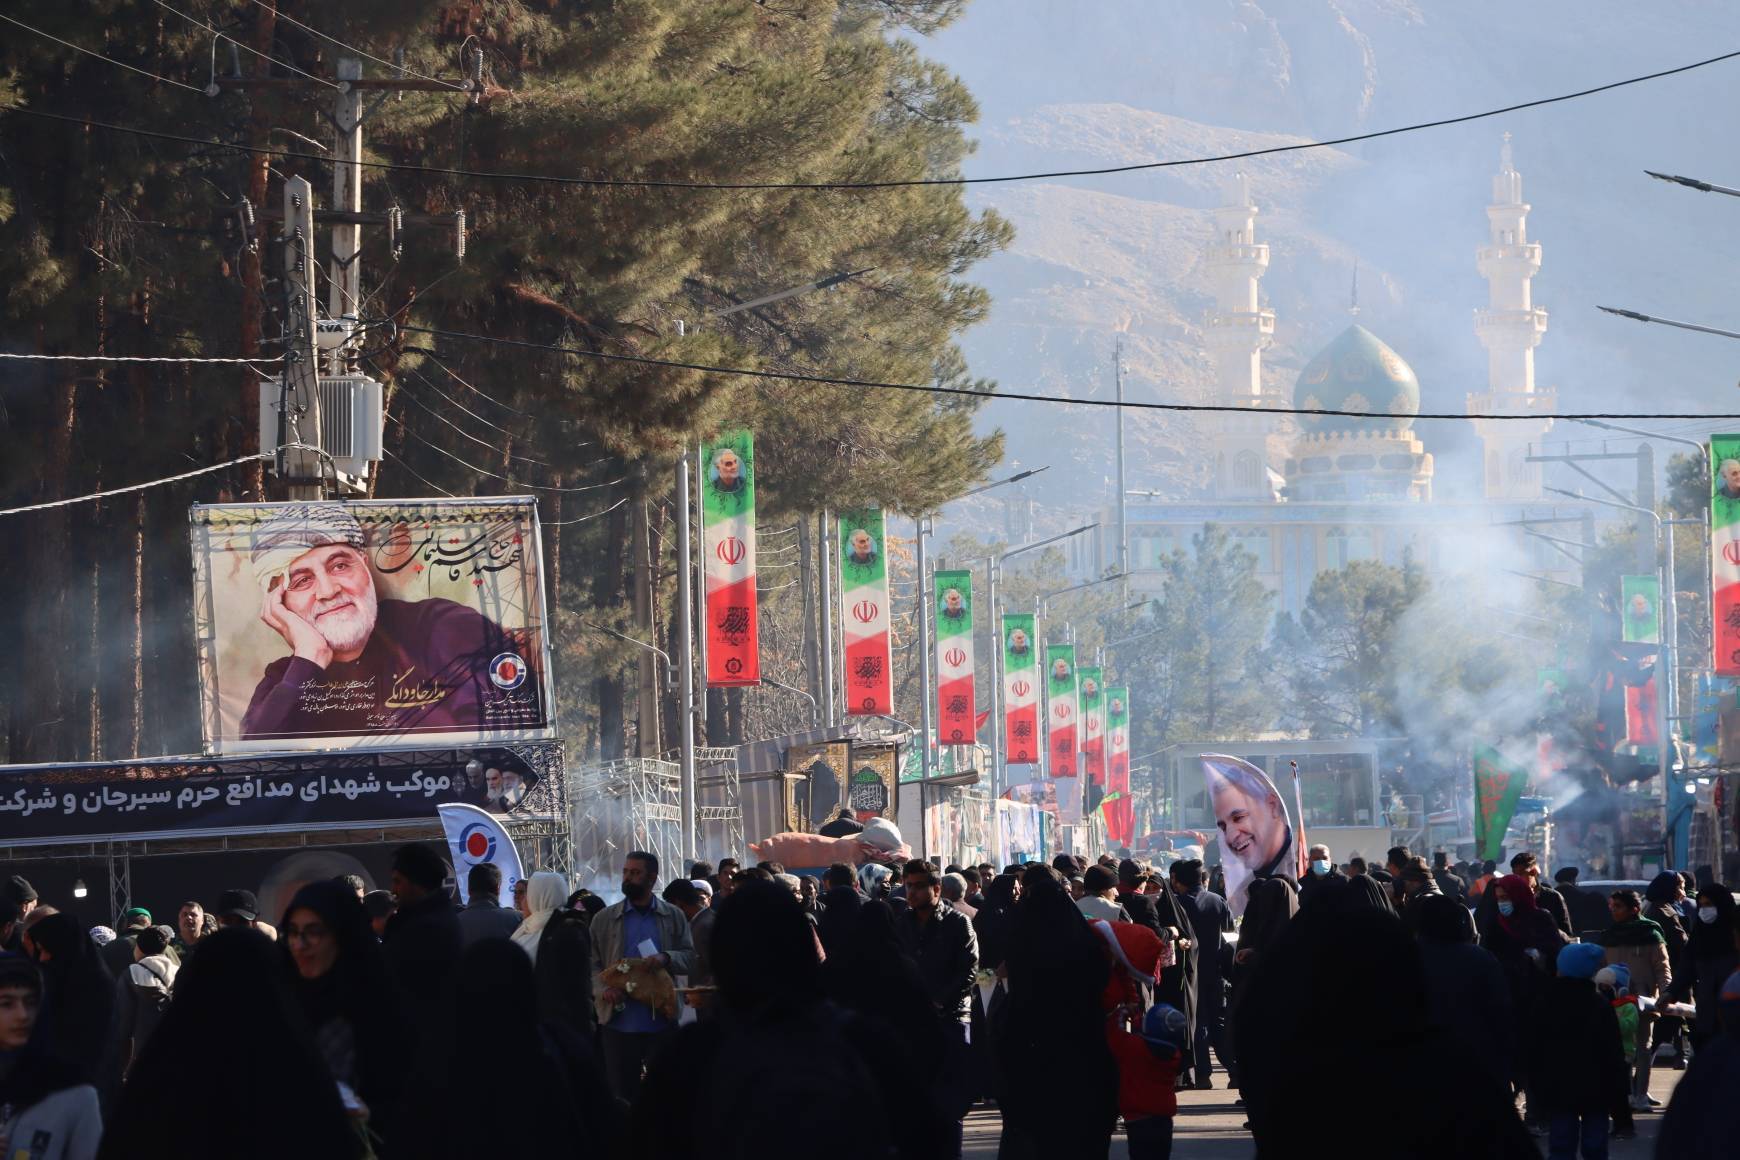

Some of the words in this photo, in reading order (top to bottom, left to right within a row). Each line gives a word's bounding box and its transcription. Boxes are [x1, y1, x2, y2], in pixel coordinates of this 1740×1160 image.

[374, 530, 487, 574] سلیمانی
[82, 785, 171, 813] سیرجان
[177, 785, 220, 809] حرم
[226, 775, 294, 806] مدافع
[299, 772, 381, 802] شهدای
[386, 769, 451, 799] موکب
[62, 793, 77, 815] و
